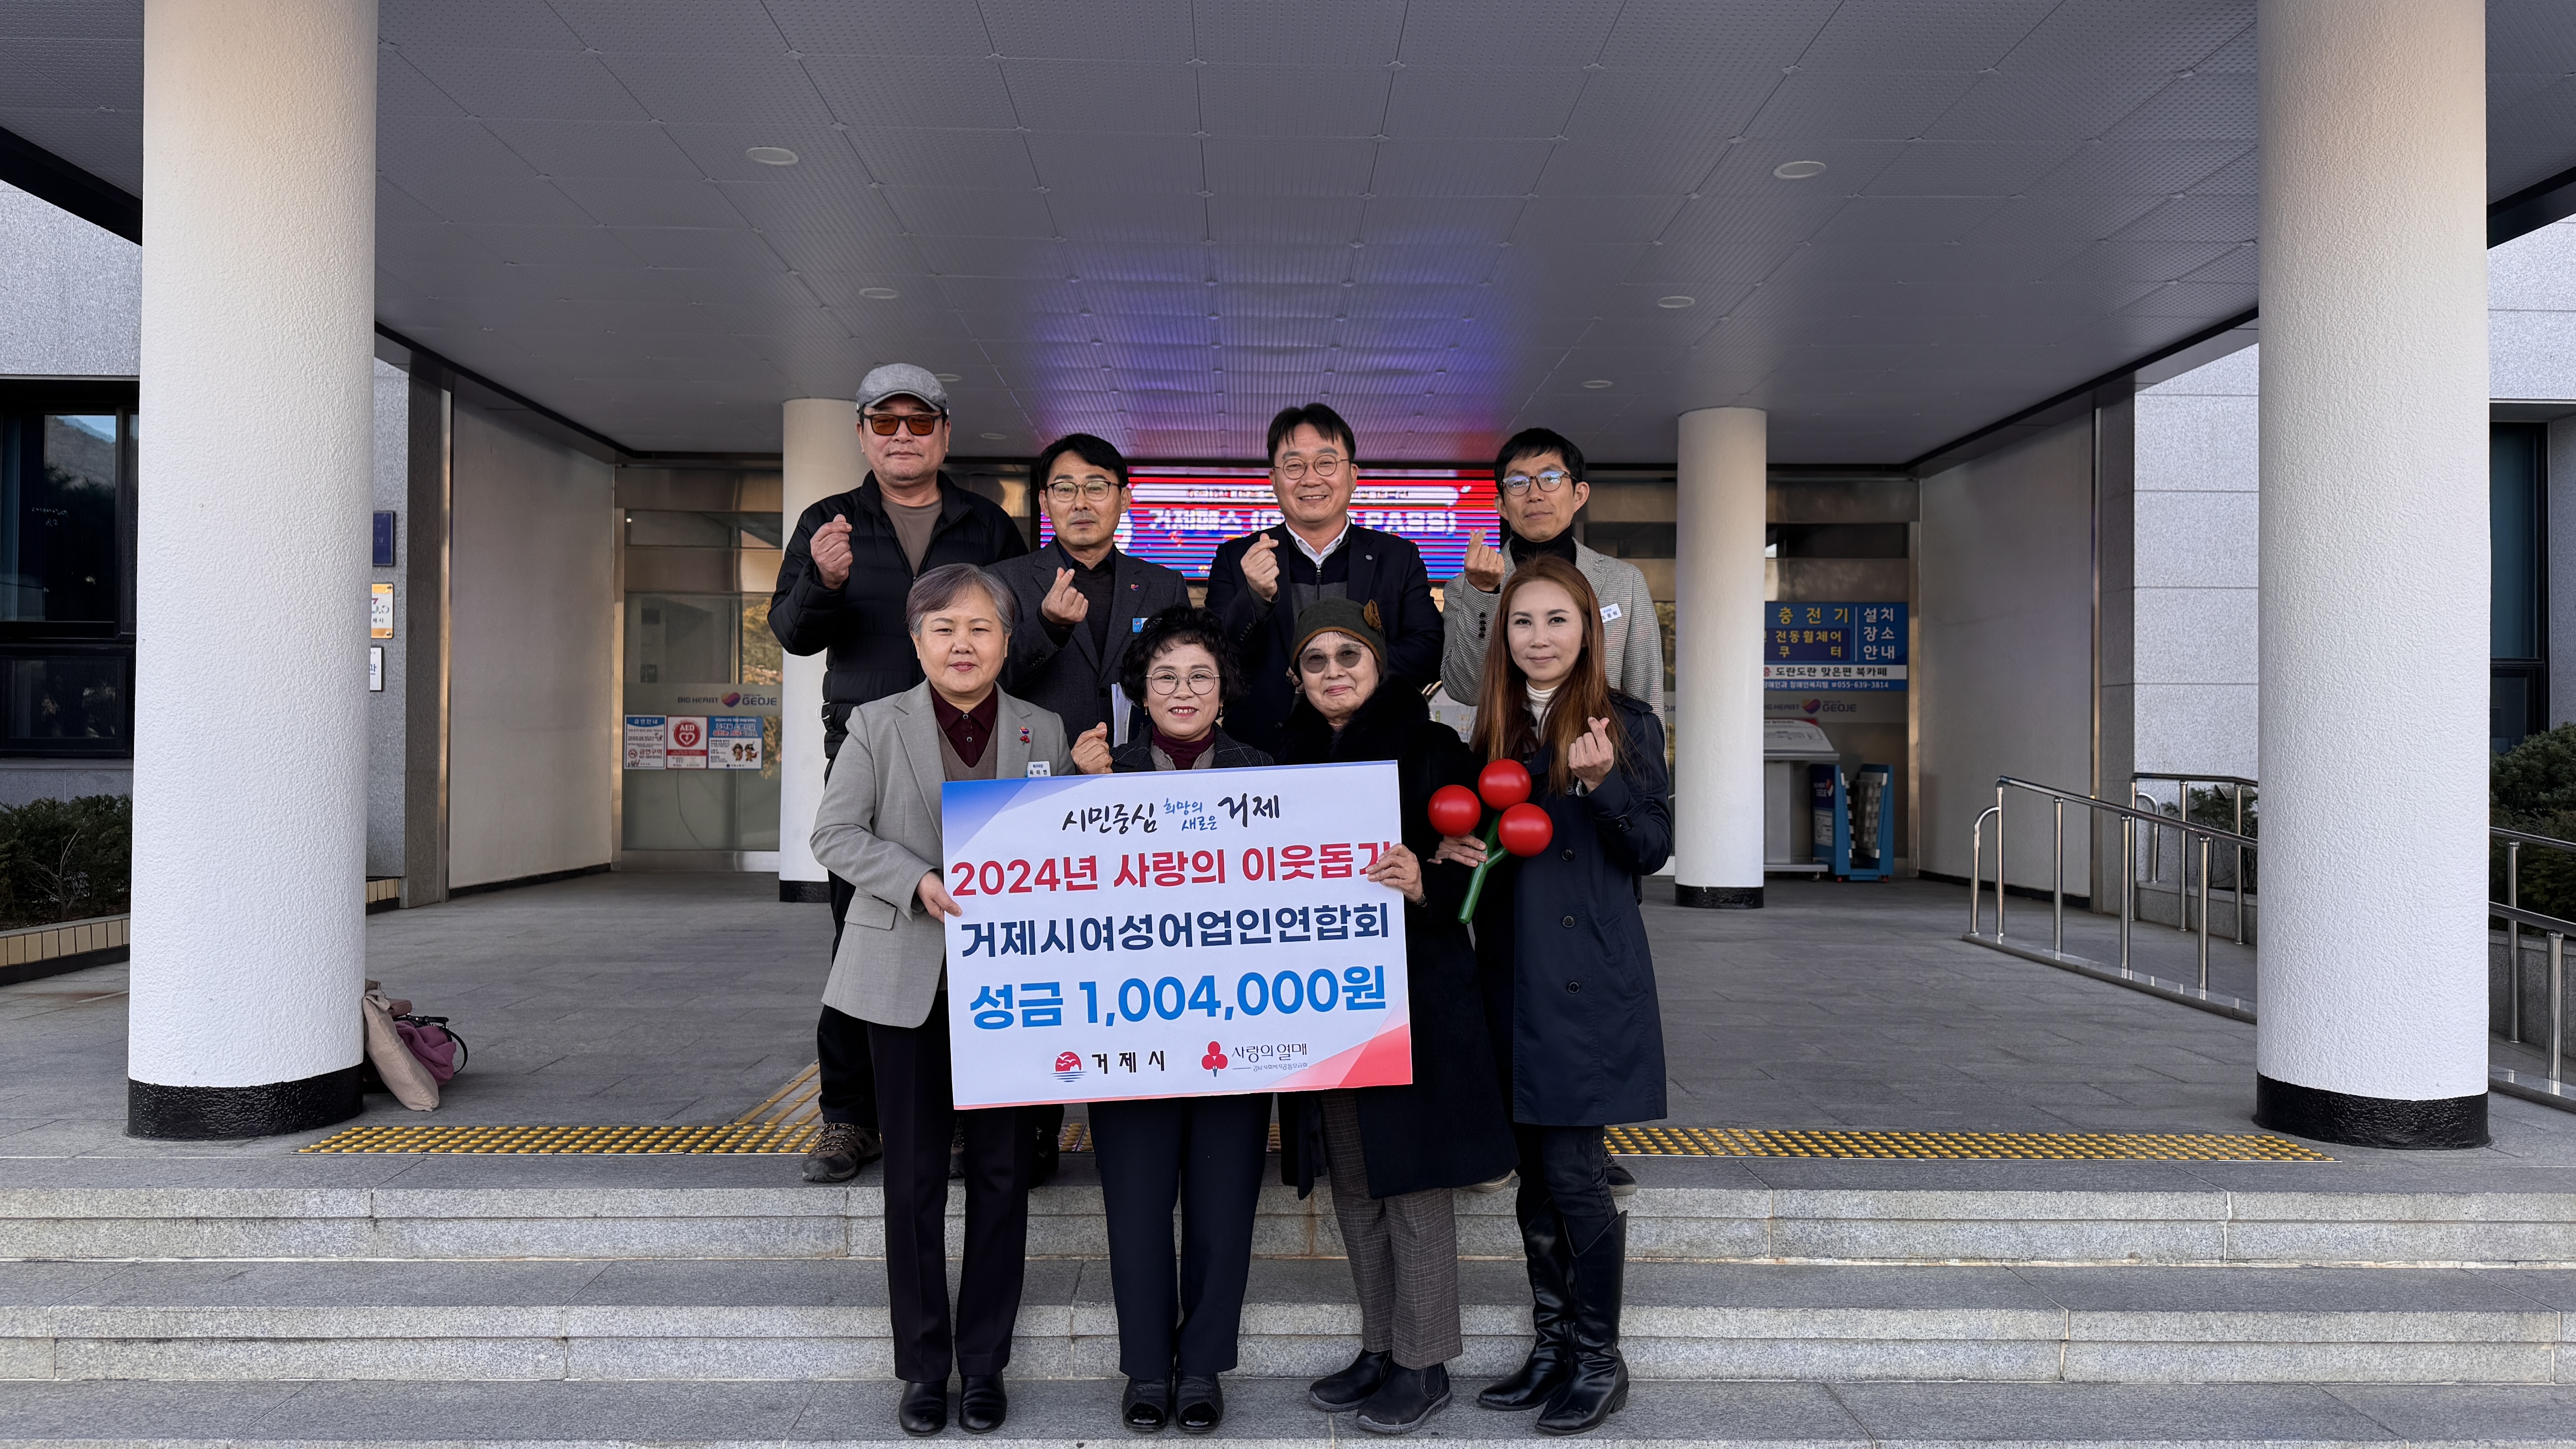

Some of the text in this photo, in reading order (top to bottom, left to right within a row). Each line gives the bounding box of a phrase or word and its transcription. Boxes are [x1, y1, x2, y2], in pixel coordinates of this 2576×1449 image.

[1864, 607, 1894, 623] 설치
[1776, 631, 1841, 643] 전동휠체어
[1864, 626, 1895, 642] 장소
[1864, 645, 1895, 660] 안내
[1776, 667, 1817, 677] 도란도란
[1856, 667, 1887, 677] 북카페
[743, 698, 777, 706] GEOJE
[1822, 704, 1857, 712] GEOJE
[1062, 793, 1279, 834] 시민중심 희망의 새로운 거제
[952, 855, 1098, 896] 2024년
[1113, 849, 1225, 888] 사랑의
[961, 902, 1389, 957] 거제시여성어업인연합회
[970, 965, 1386, 1030] 성금 1,004,000원
